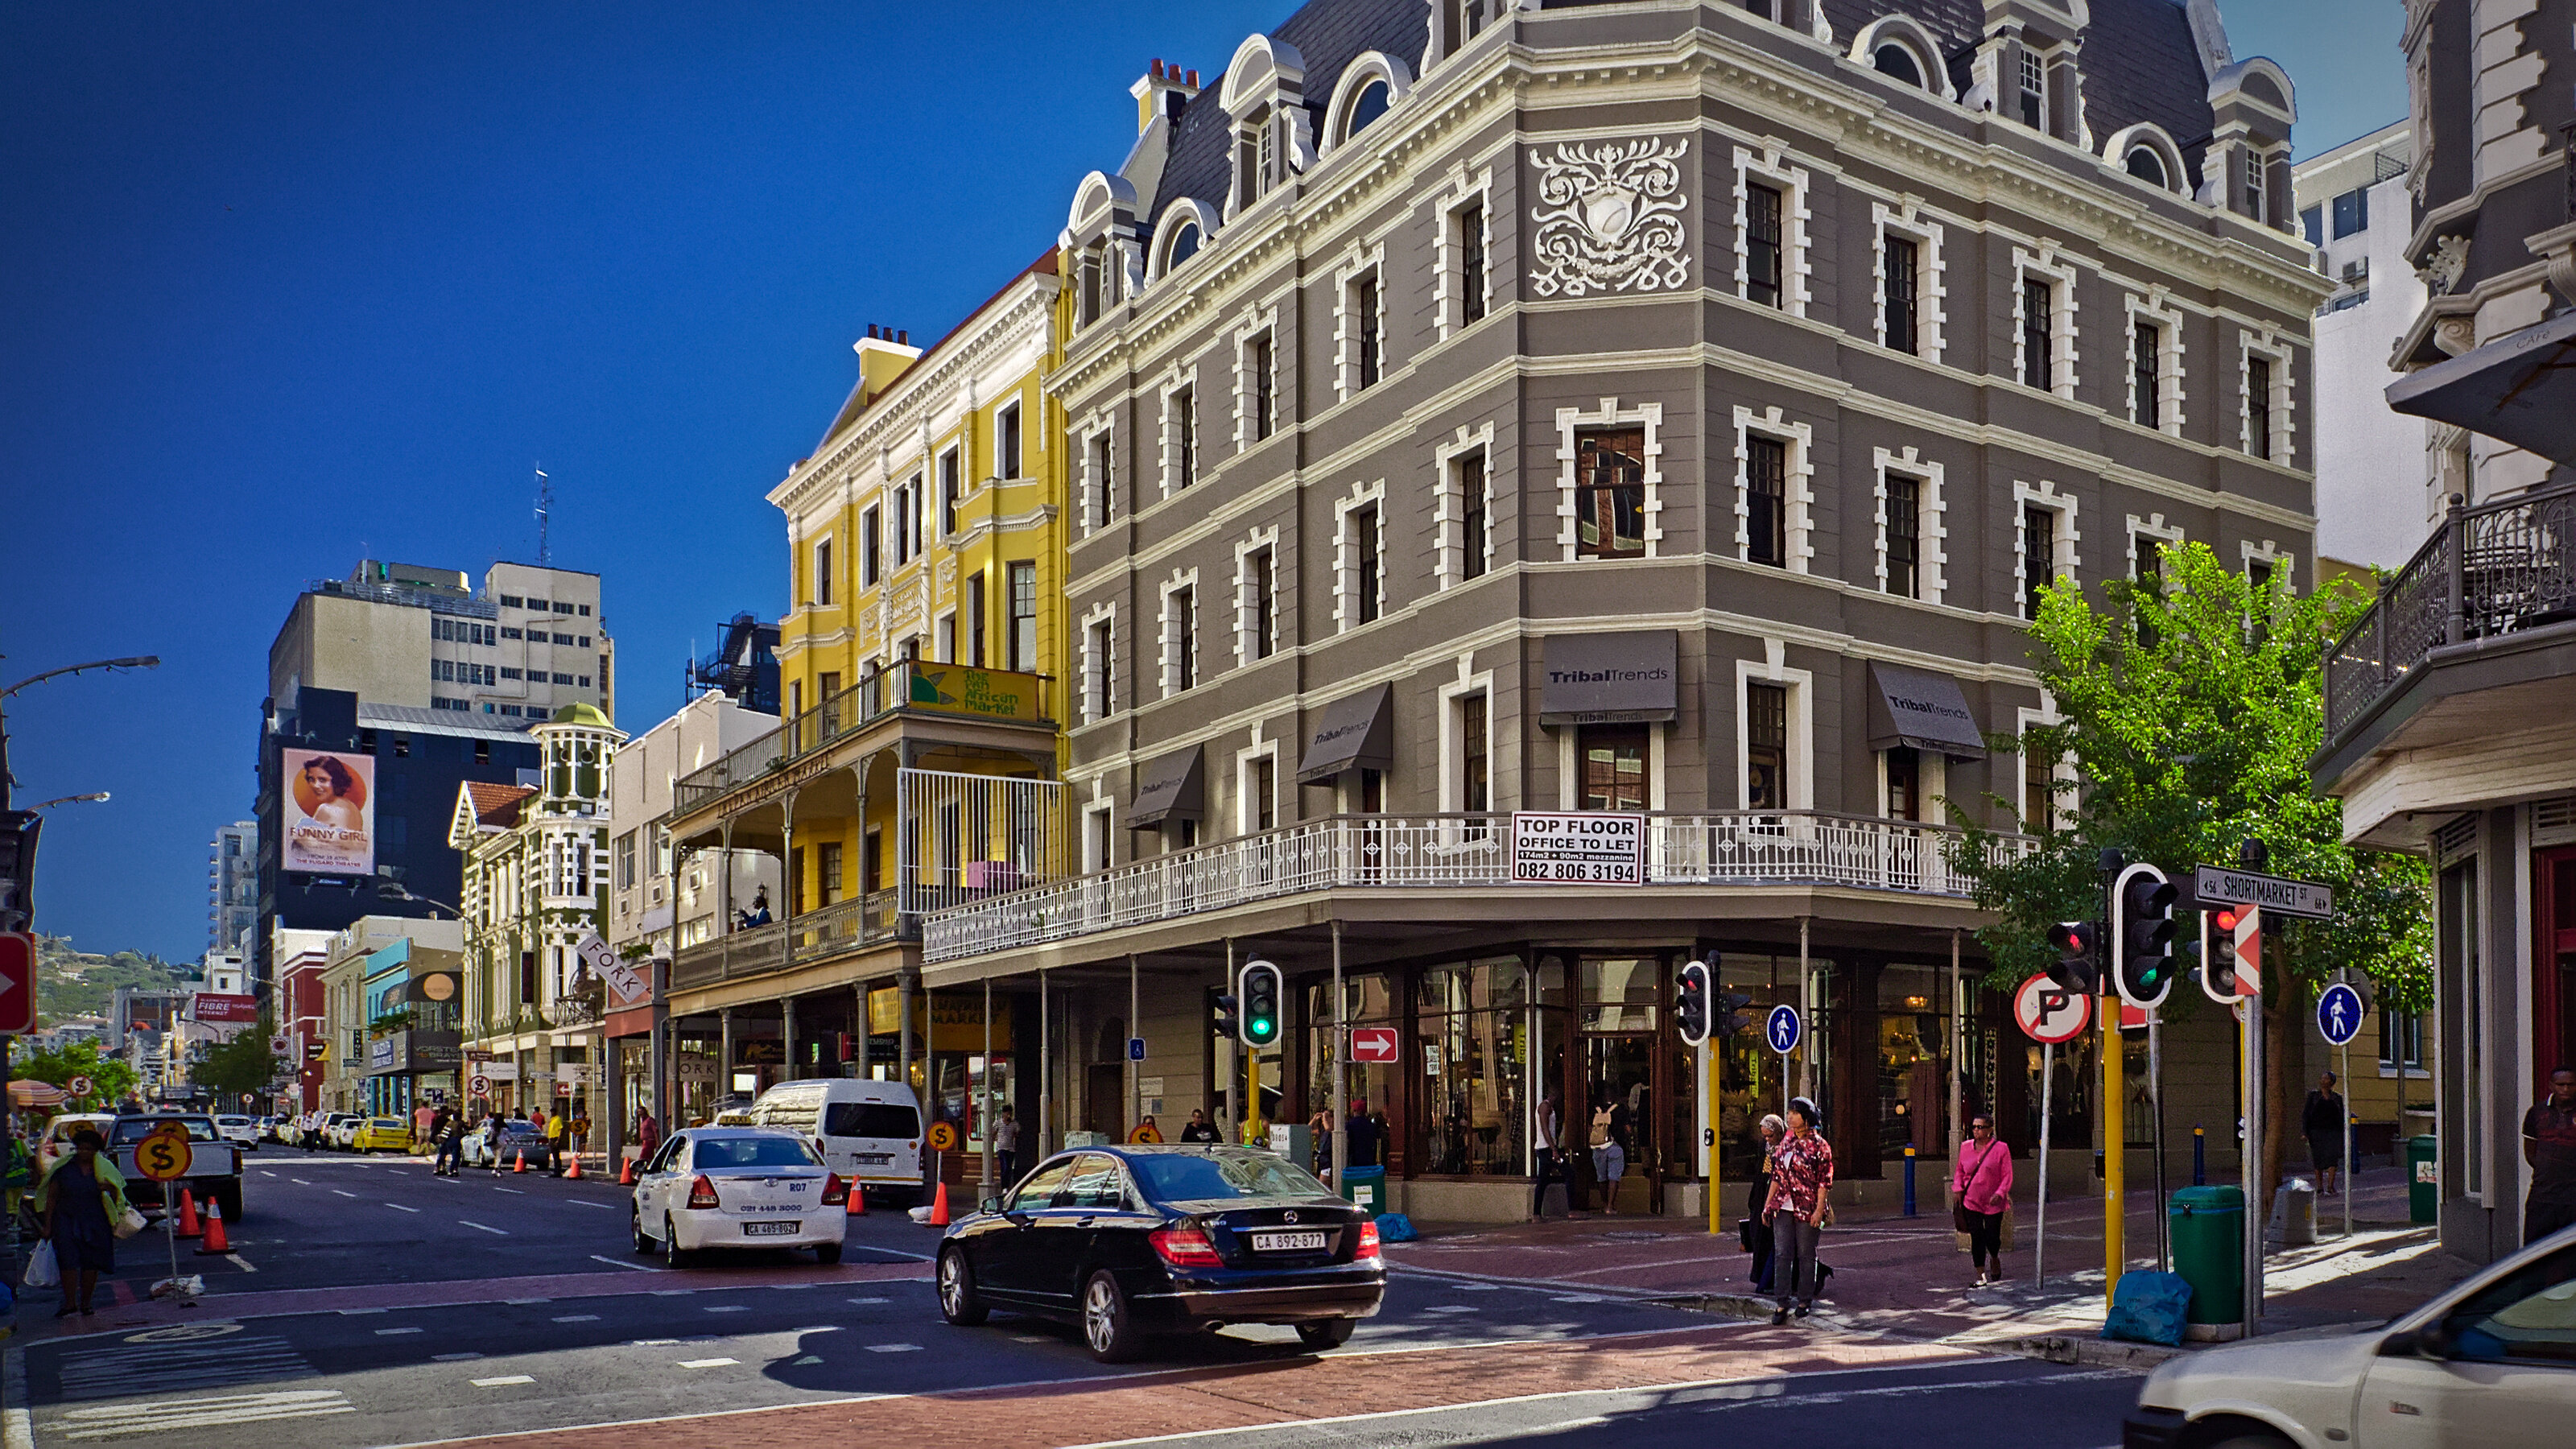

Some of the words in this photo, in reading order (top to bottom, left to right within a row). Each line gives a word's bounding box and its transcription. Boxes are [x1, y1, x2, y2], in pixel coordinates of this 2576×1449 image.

[1550, 667, 1668, 683] TribalTrends
[1888, 696, 1969, 720] TribalTrends
[1571, 712, 1643, 723] TribalTrends
[1520, 819, 1560, 833] TOP
[1567, 820, 1635, 835] FLOOR
[290, 828, 335, 840] FUNNY
[339, 831, 367, 843] GIRL
[1519, 837, 1575, 848] OFFICE
[1579, 838, 1600, 849] TO
[1606, 840, 1635, 851] LET
[1519, 851, 1550, 859] 174m2
[1559, 851, 1584, 860] 90m2
[1586, 853, 1634, 862] mezzanine
[1517, 862, 1549, 878] 082
[1554, 863, 1587, 879] 806
[1592, 864, 1635, 881] 3194
[2224, 875, 2297, 906] SHORTMARKET
[2299, 887, 2308, 899] ST
[588, 941, 639, 992] FORK
[199, 1001, 230, 1011] FIBRE
[2038, 989, 2070, 1026] P
[679, 1063, 714, 1075] ORK
[789, 1183, 807, 1192] R07
[749, 1225, 758, 1233] CA
[762, 1224, 793, 1233] 465-802
[1256, 1236, 1271, 1249] CA
[1276, 1234, 1322, 1248] 892-877
